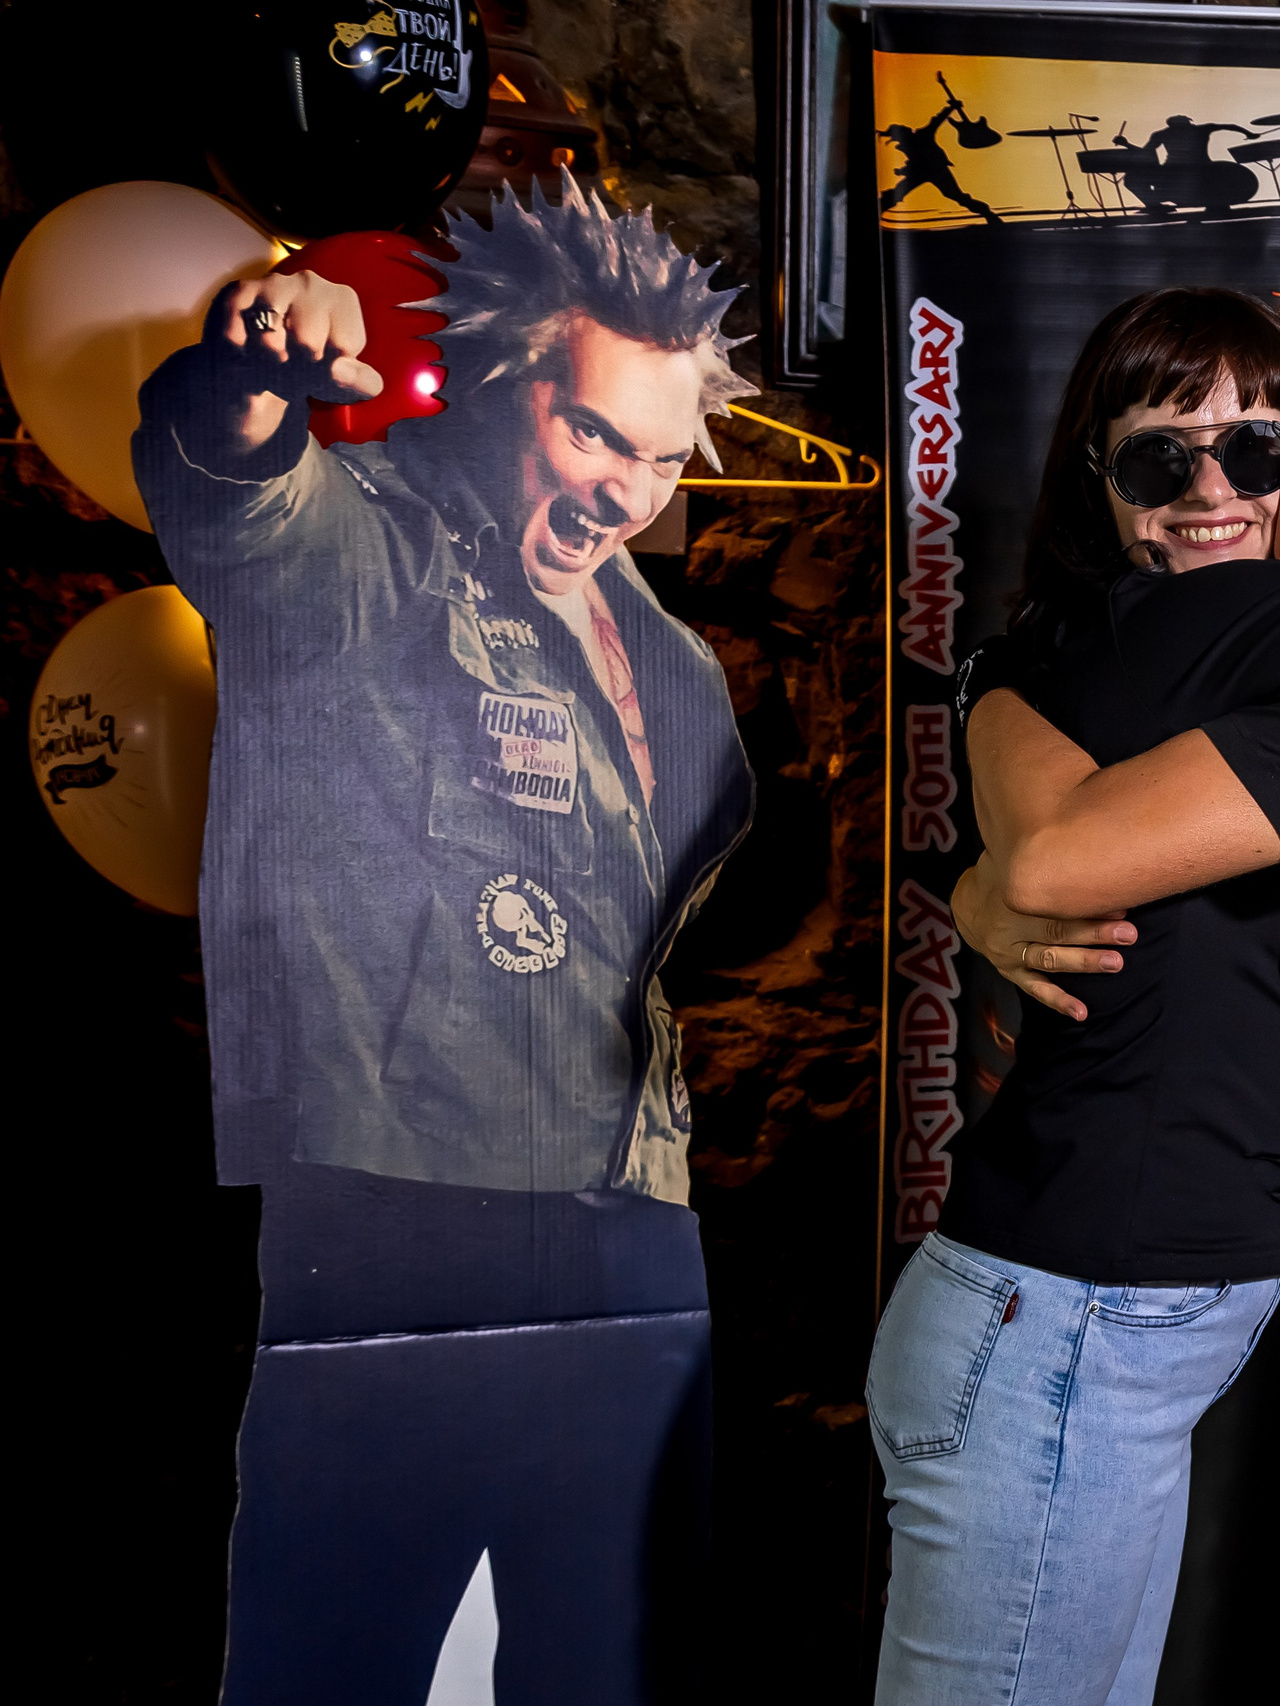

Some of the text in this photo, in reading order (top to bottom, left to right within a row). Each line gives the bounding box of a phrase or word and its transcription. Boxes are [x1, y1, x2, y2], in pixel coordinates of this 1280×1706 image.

[394, 8, 450, 42] ТВОЙ
[382, 42, 458, 81] ДЕНЬ!
[896, 297, 964, 1243] BIRTHDAY 50TH ANNIVERSARY
